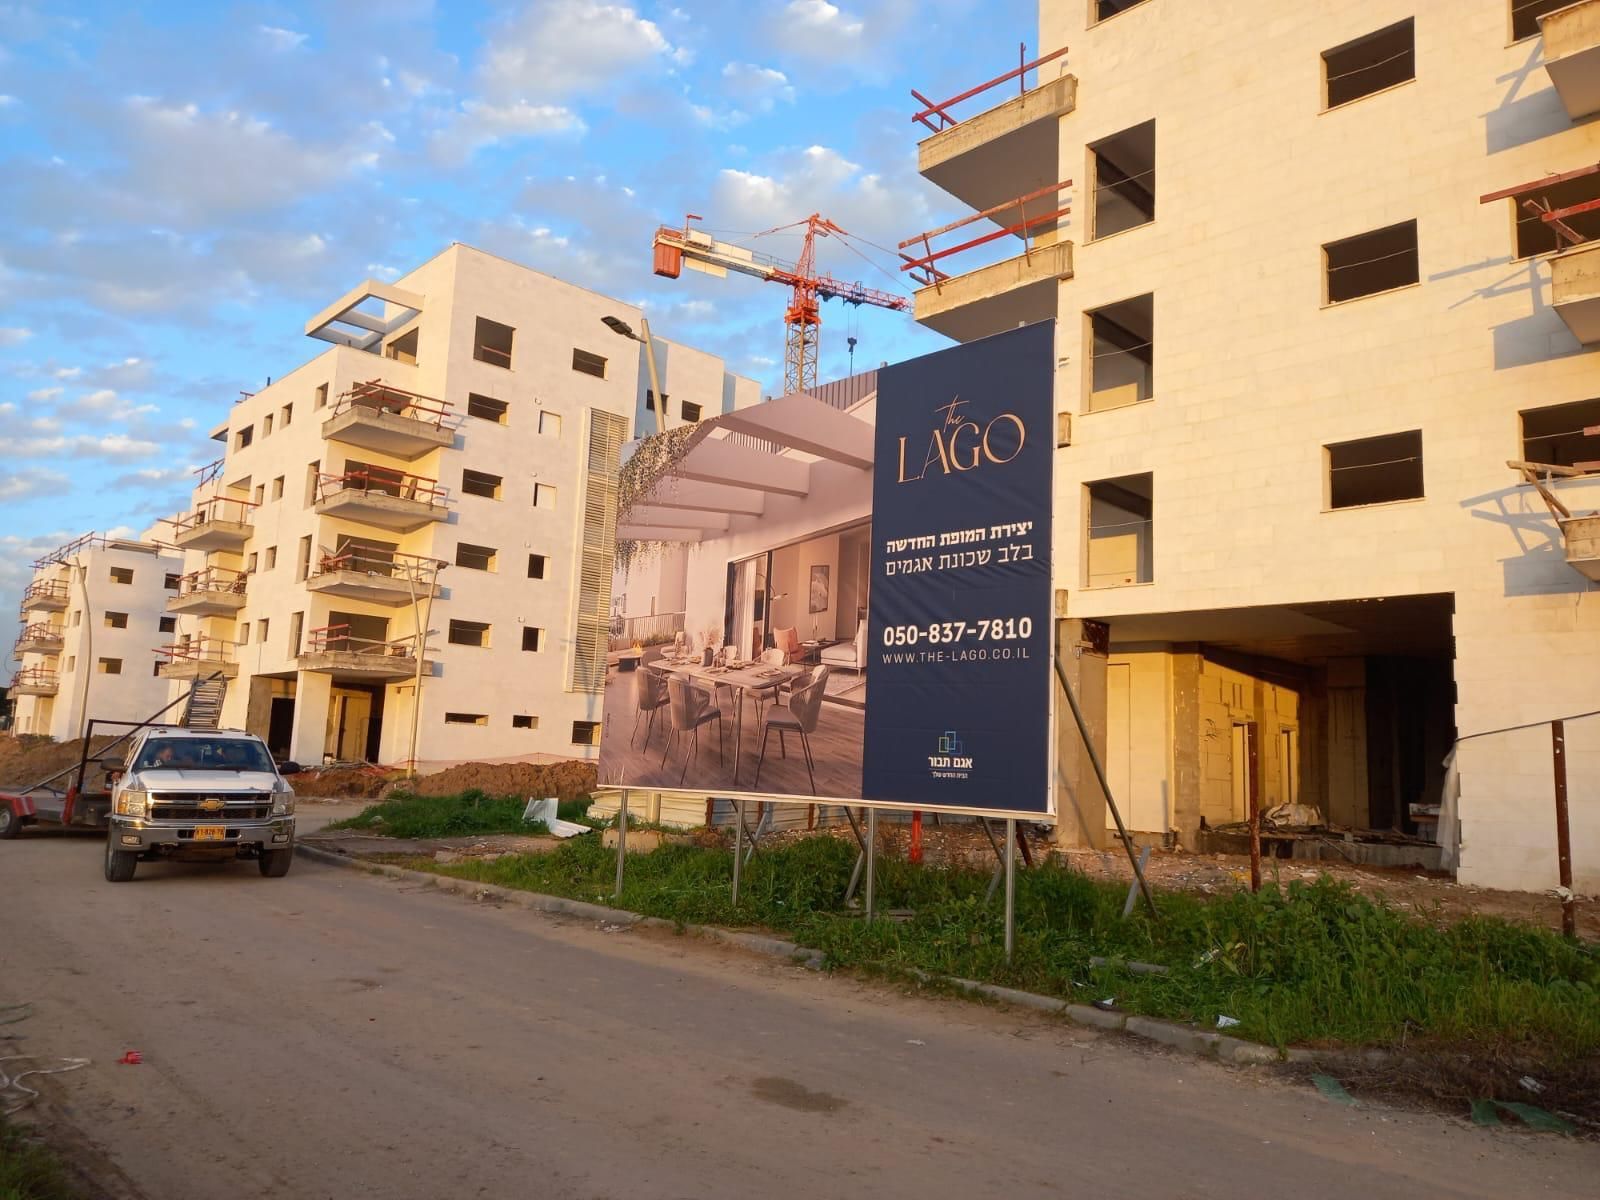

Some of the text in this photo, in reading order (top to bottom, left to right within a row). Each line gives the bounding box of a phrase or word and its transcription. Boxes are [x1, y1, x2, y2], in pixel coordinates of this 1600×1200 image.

[935, 395, 969, 432] the
[897, 413, 1025, 484] LAGO
[886, 521, 1033, 553] יצירת המופת החדשה
[886, 544, 1033, 575] בלב שכונת אגמים
[883, 617, 1032, 646] 050-837-7810
[882, 648, 1030, 664] WWW.THE-LAGO.CO.IL
[928, 756, 973, 769] אגם תבור
